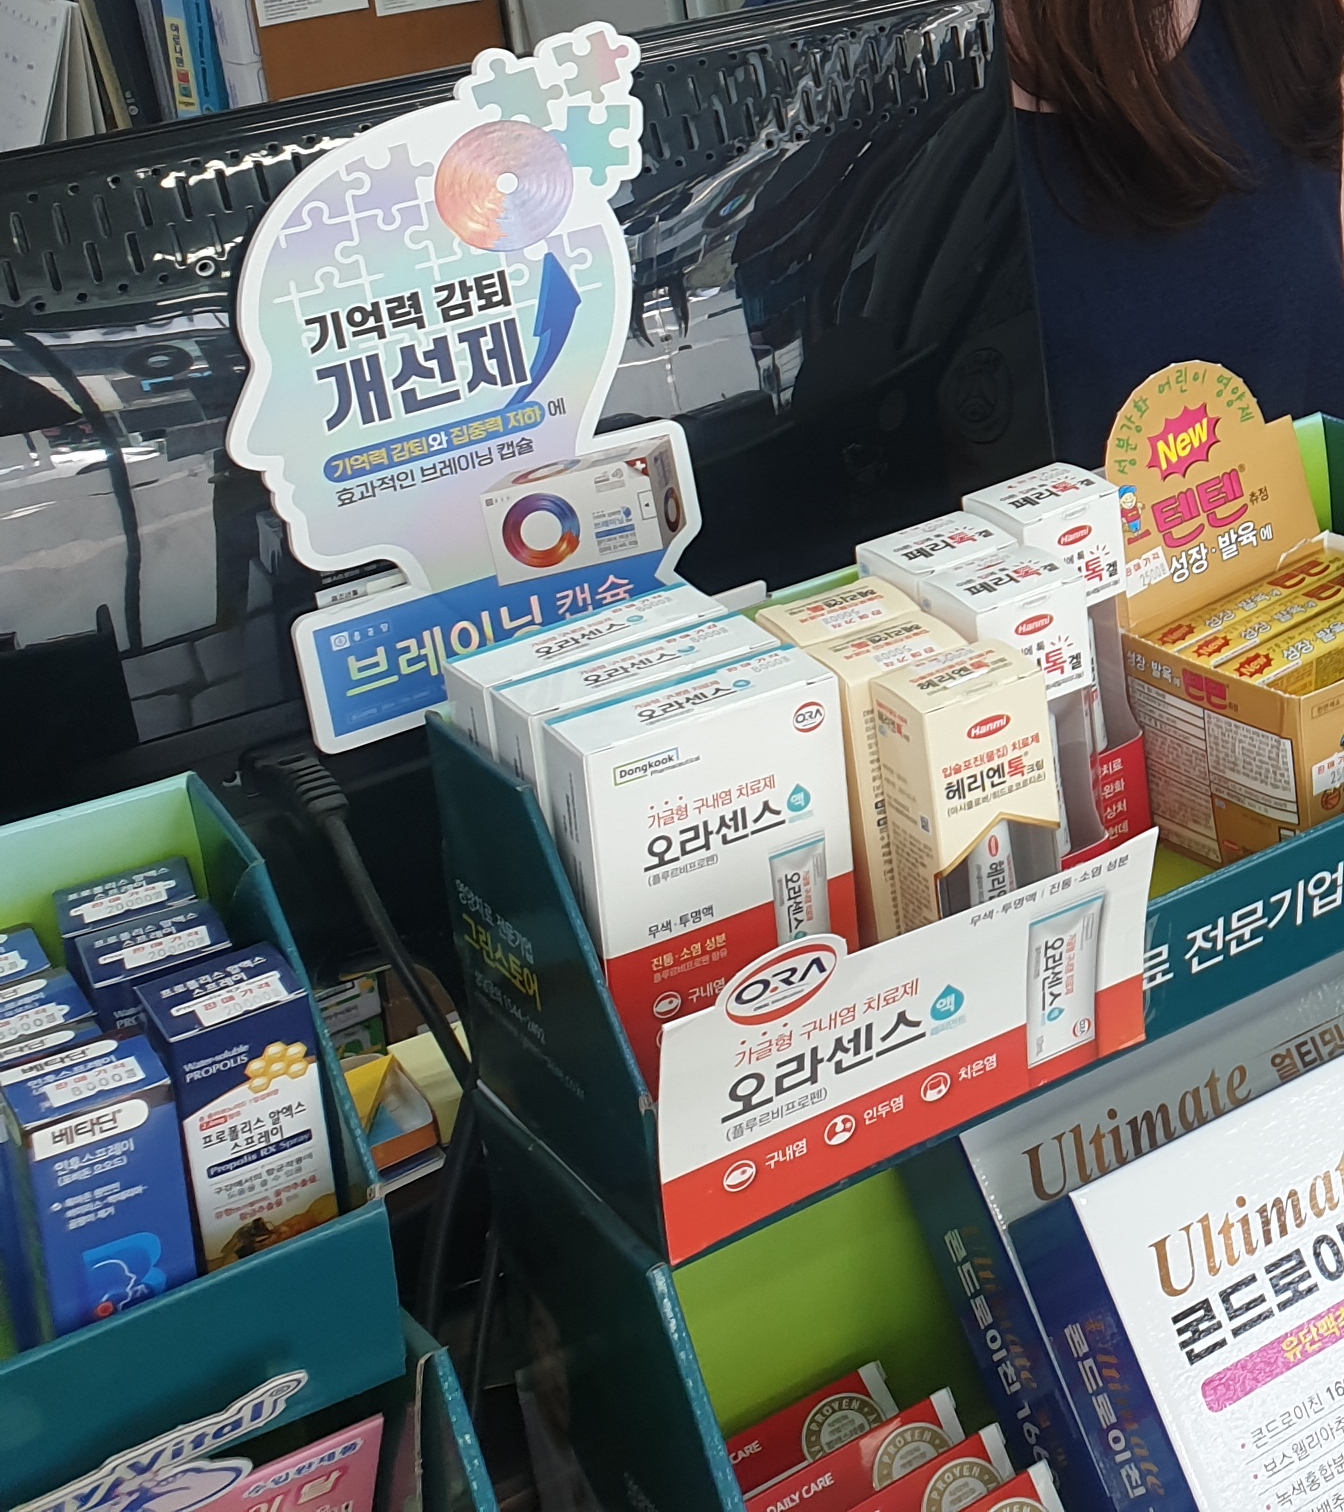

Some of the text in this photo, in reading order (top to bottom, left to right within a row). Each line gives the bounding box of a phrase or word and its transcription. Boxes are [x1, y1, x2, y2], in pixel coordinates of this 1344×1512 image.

[304, 269, 513, 355] 기억력 감퇴
[315, 317, 530, 433] 개선제
[331, 397, 567, 479] 기억력 감퇴와 집중력 저하 에
[1157, 414, 1210, 472] New
[335, 436, 535, 508] 효과적인 브레이닝 캡슐
[1153, 466, 1248, 550] 텐텐
[1015, 615, 1054, 634] Hanmi
[794, 708, 824, 725] ORA
[969, 716, 1012, 738] Hanmi
[619, 753, 676, 780] Dongkook
[647, 774, 777, 830] 가글형 구내염 치료제
[643, 798, 788, 874] 오라센스
[734, 958, 829, 1006] ORA
[184, 1054, 250, 1085] PROPOLIS
[720, 1009, 928, 1125] 오라센스
[959, 1053, 998, 1083] 치은염
[51, 1109, 120, 1146] 베타딘
[201, 1100, 308, 1149] 프로폴리스 알엑스
[863, 1096, 905, 1126] 인두염
[1023, 1062, 1253, 1203] Ultimate
[229, 1126, 286, 1154] 스프레이
[765, 1138, 809, 1170] 구내염
